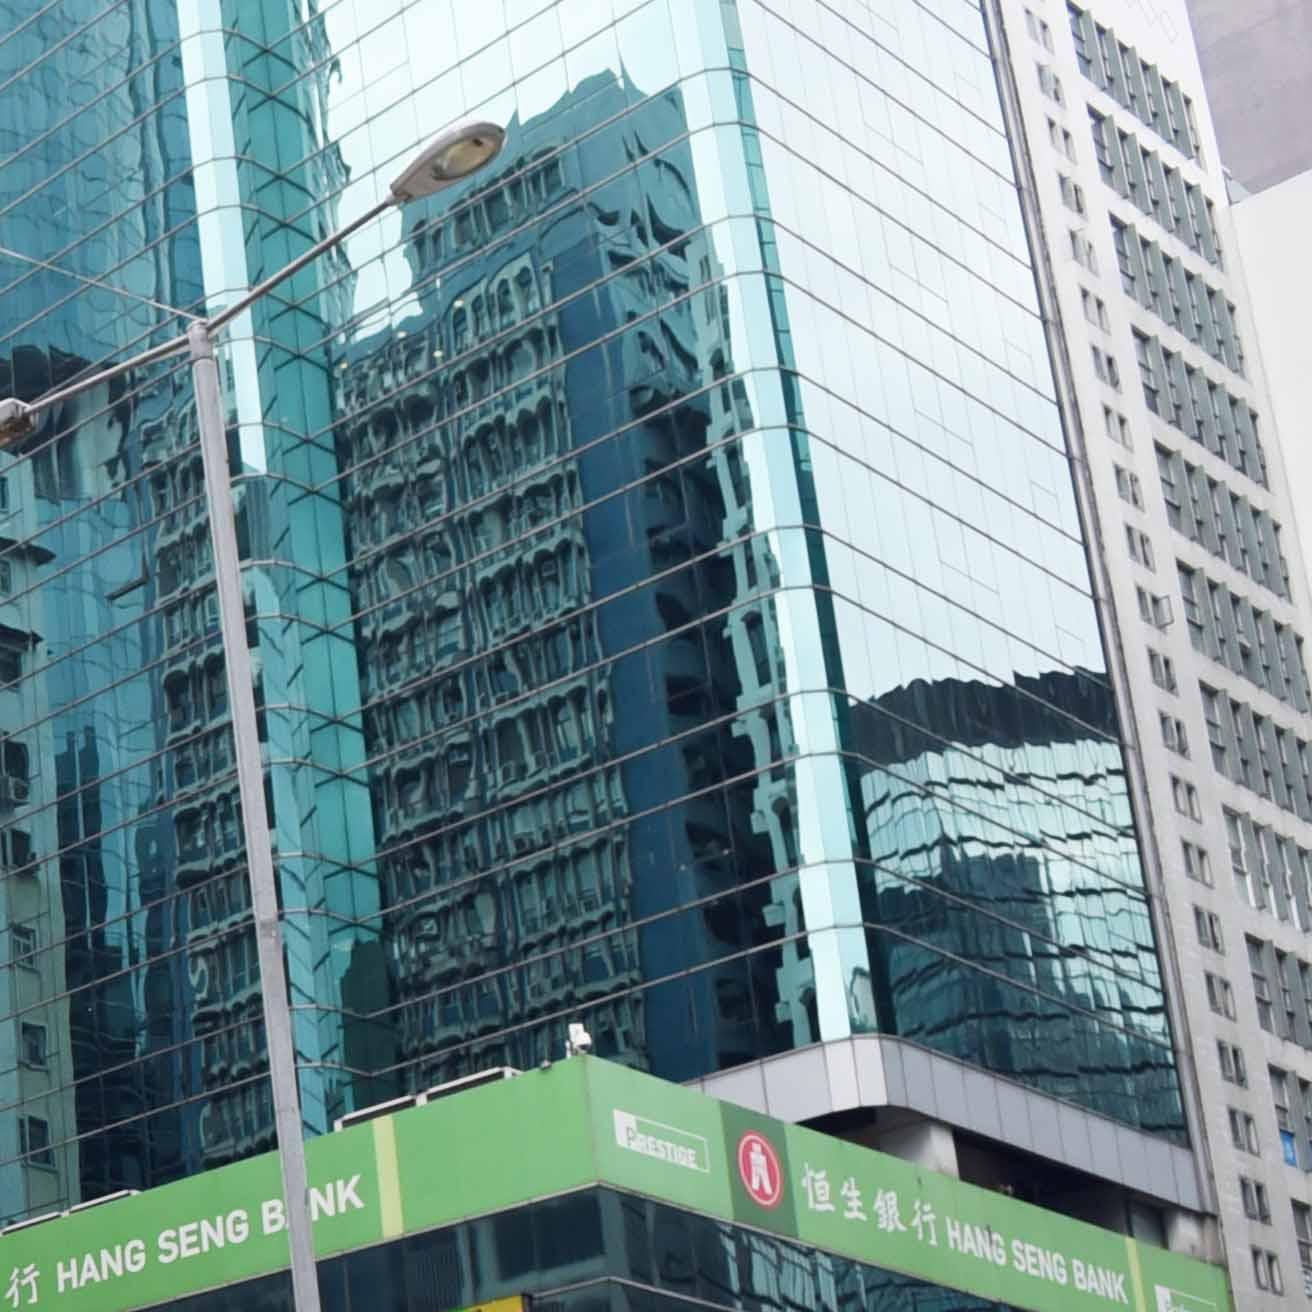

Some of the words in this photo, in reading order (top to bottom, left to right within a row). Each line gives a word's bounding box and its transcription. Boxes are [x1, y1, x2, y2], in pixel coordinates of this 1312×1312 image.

[56, 1237, 147, 1294] HANG
[156, 1207, 251, 1266] SENG
[260, 1173, 366, 1236] BNK
[944, 1214, 1007, 1267] HANG
[1010, 1237, 1069, 1287] SENG
[1070, 1256, 1129, 1305] BANK
